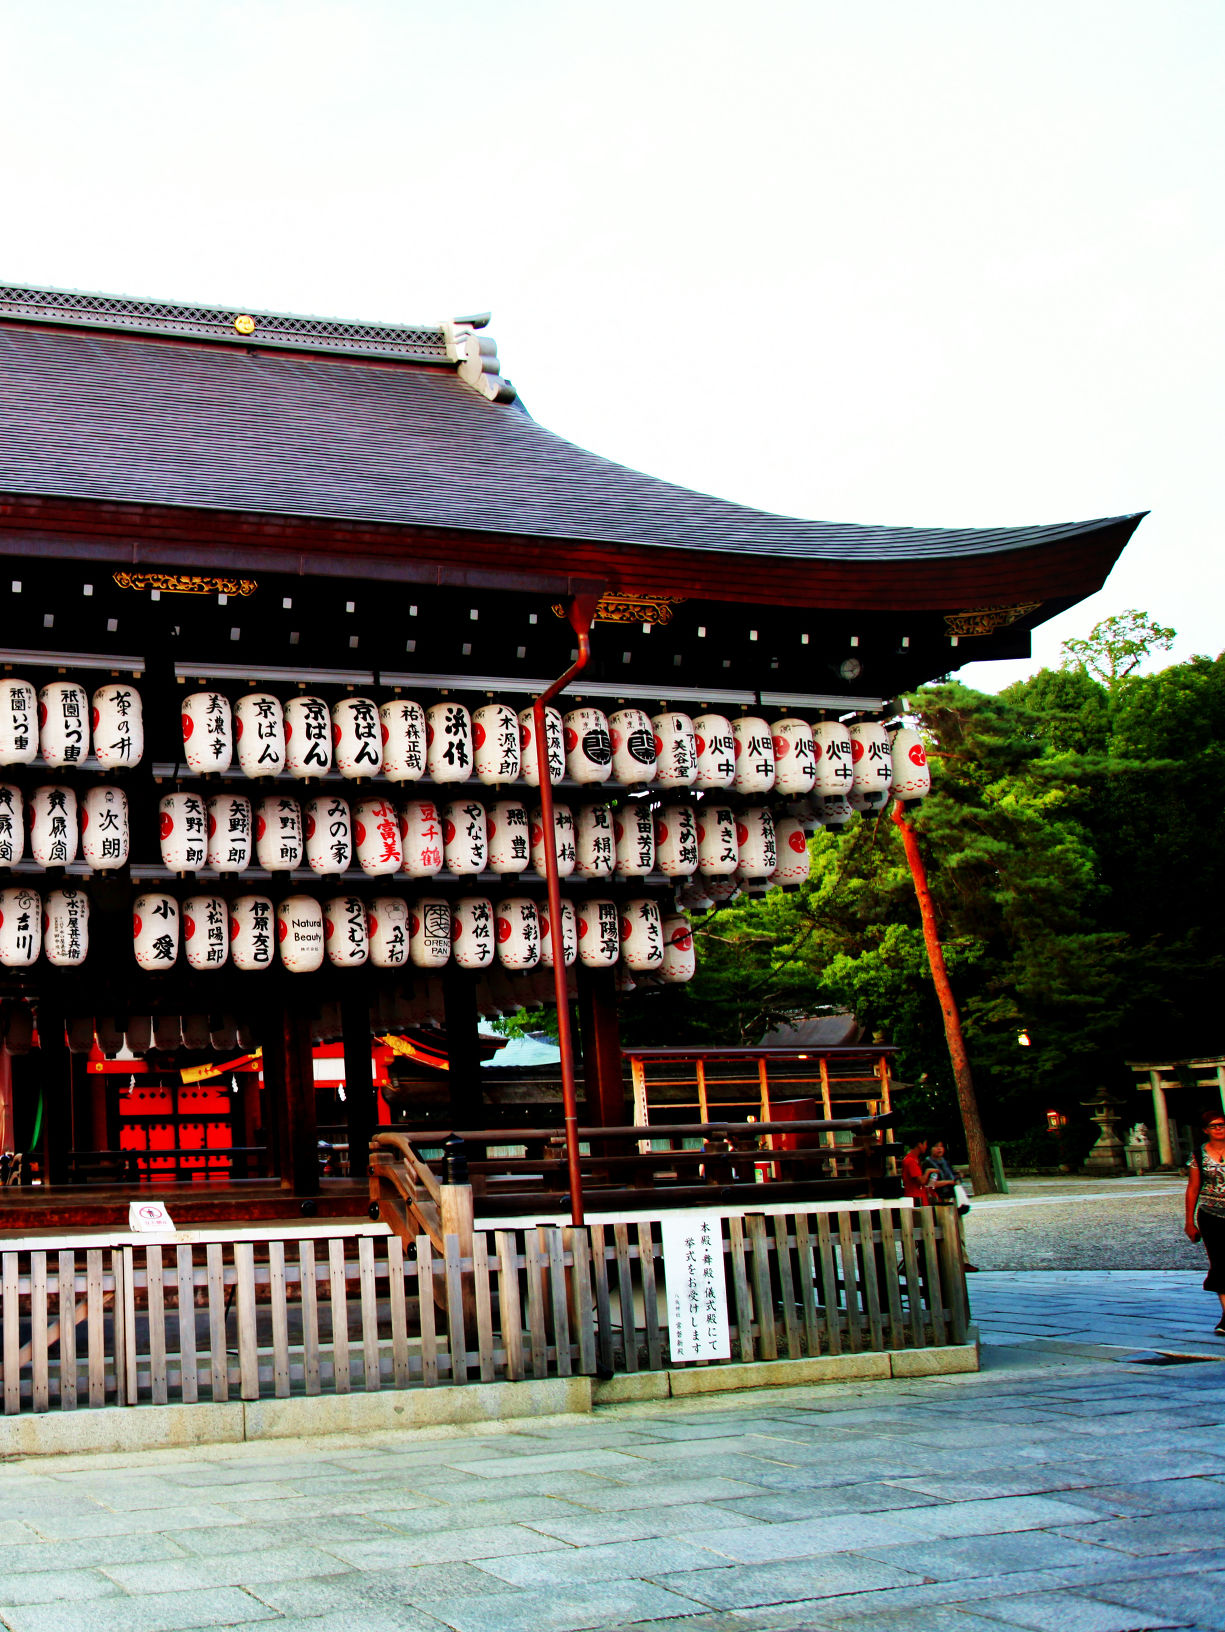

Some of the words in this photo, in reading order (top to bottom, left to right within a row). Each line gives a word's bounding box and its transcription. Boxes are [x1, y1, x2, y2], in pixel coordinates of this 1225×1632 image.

[206, 695, 227, 760] 美濃幸
[253, 698, 279, 764] 京ばん
[300, 699, 328, 767] 京ばん
[349, 700, 379, 766] 京ばん
[709, 736, 735, 777] 畑中
[748, 736, 774, 777] 畑中
[795, 738, 816, 779] 畑中
[827, 740, 853, 779] 畑中
[869, 741, 892, 780] 畑中
[183, 797, 204, 865] 矢野一郎
[227, 800, 247, 864] 矢野一郎
[278, 799, 297, 863] 矢野一郎
[327, 799, 349, 864] みの家
[463, 804, 485, 866] やなぎ
[17, 912, 32, 960] 吉川
[152, 900, 176, 961] 小愛
[206, 899, 223, 963] 小松陽一郎
[294, 932, 322, 943] Beauty
[599, 904, 618, 960] 開陽亭
